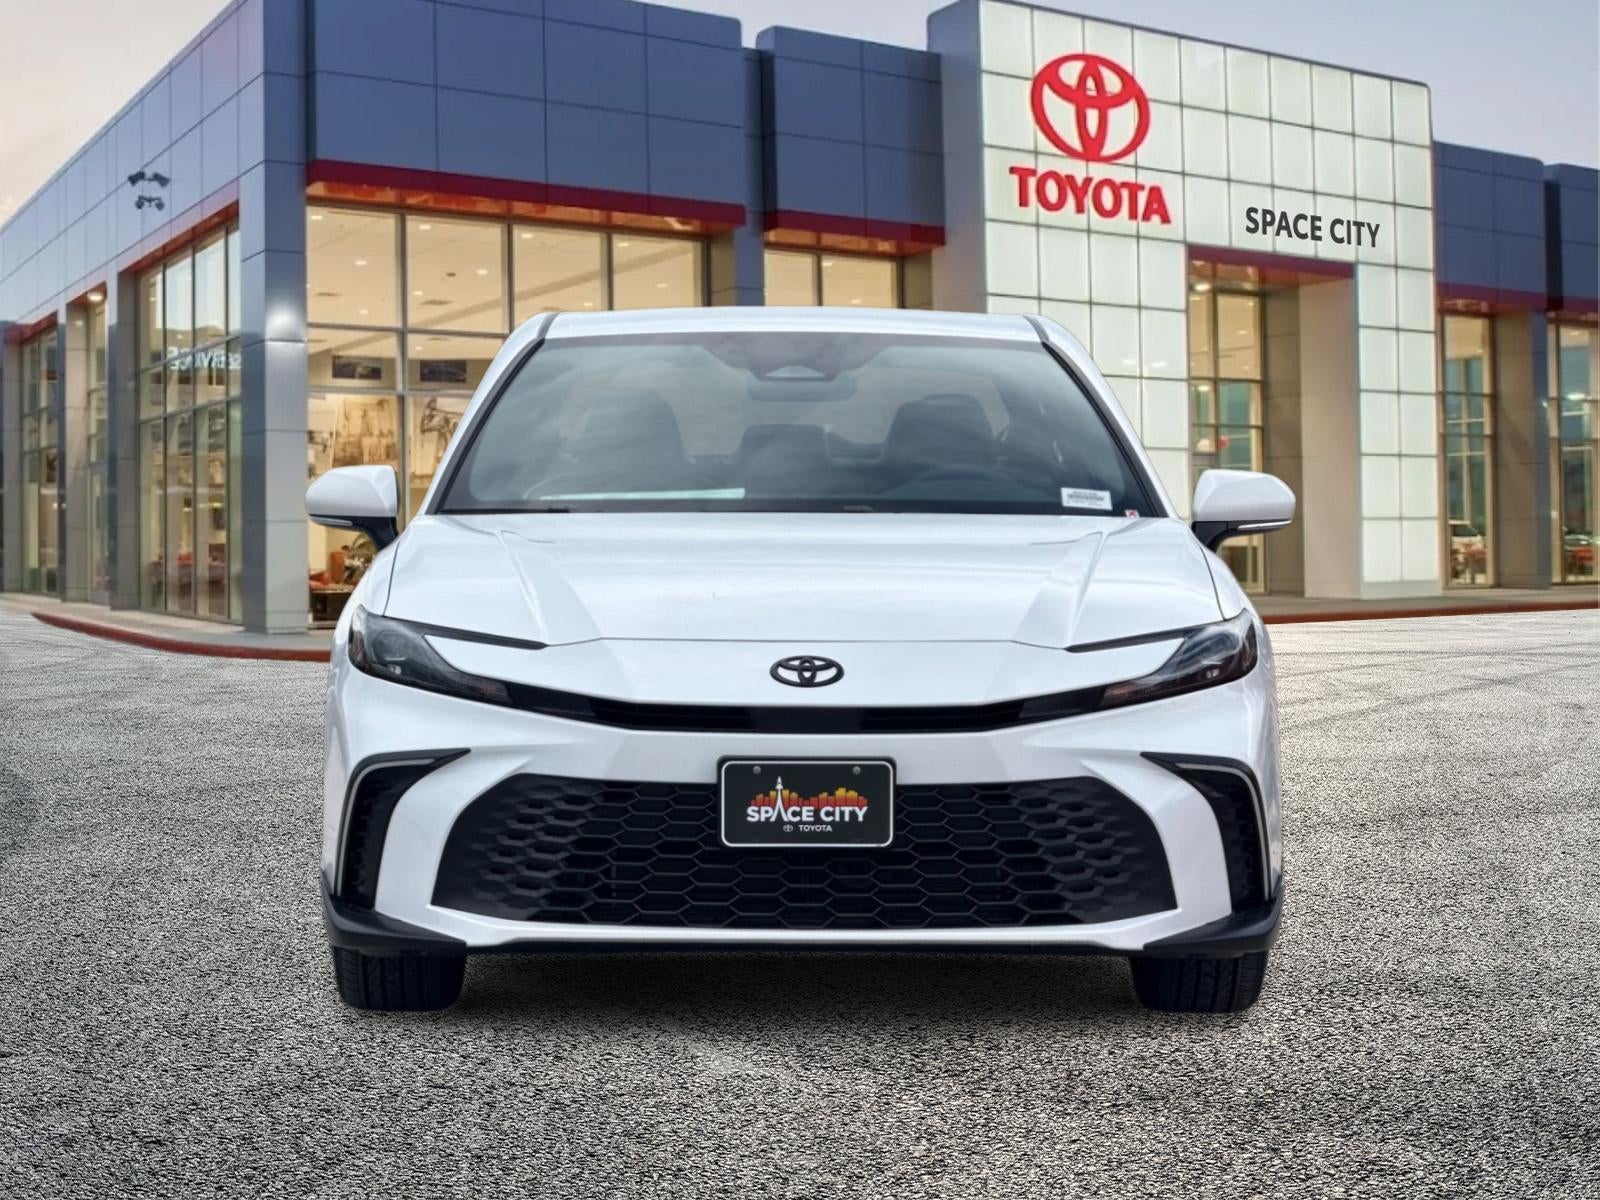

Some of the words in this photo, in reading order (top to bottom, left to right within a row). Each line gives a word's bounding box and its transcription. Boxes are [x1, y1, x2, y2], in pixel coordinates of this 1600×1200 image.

[1009, 166, 1171, 224] TOYOTA
[1245, 206, 1323, 241] SPACE
[1329, 218, 1381, 248] CITY
[746, 805, 815, 822] SPACE
[819, 806, 868, 822] CITY
[798, 824, 833, 832] TOYOTA
